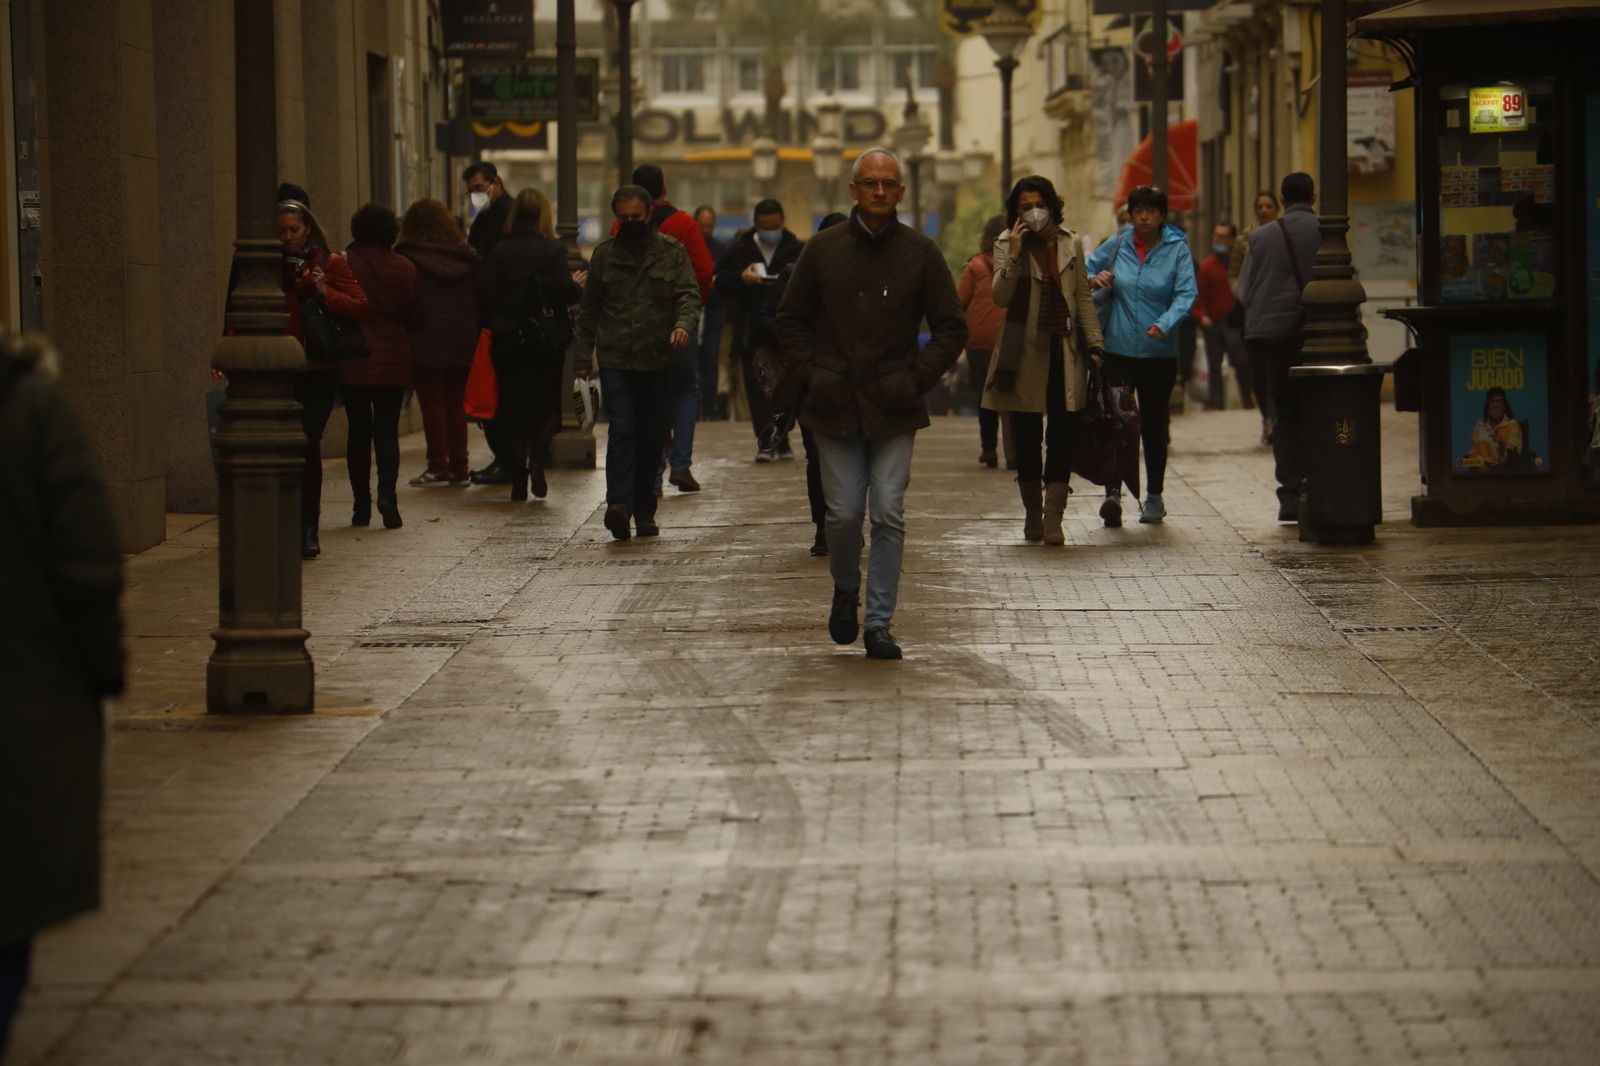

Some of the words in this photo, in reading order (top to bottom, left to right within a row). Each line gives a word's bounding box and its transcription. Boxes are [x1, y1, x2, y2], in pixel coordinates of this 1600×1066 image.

[1503, 94, 1521, 112] 89
[1471, 347, 1524, 368] BIEN
[1466, 367, 1524, 391] JUGADO
